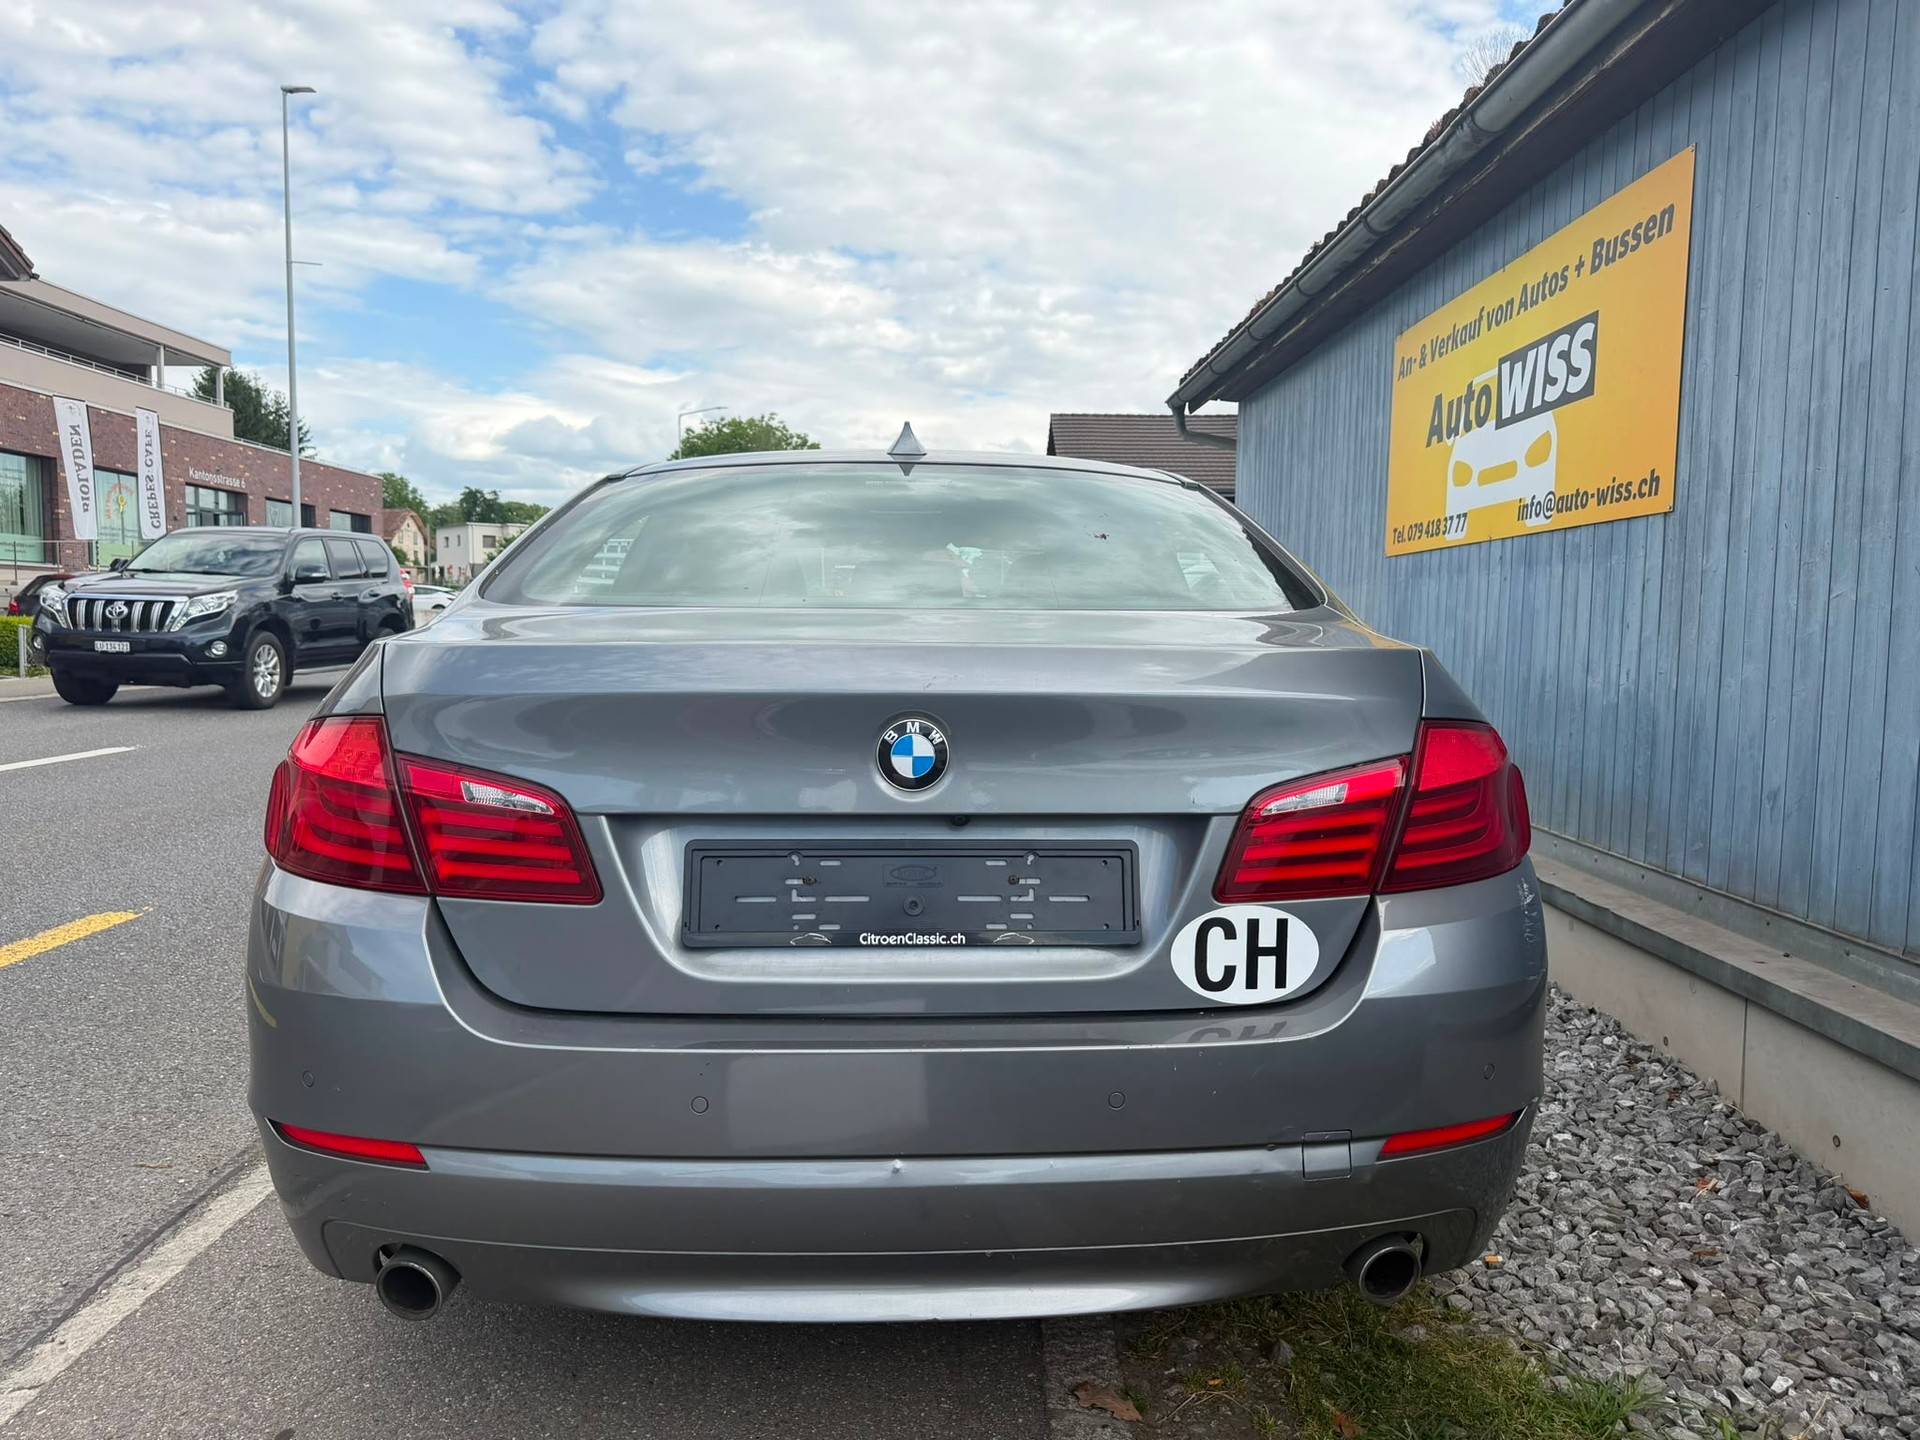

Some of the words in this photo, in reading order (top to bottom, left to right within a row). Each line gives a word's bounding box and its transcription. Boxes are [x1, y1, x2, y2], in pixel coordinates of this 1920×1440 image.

[1397, 352, 1417, 381] An-
[1418, 343, 1428, 369] &
[1430, 306, 1485, 363] Verkauf
[1486, 296, 1515, 332] von
[1516, 264, 1570, 317] Autos
[1574, 254, 1586, 278] +
[1590, 203, 1675, 275] Bussen
[1425, 380, 1492, 448] Auto
[1501, 322, 1596, 420] WISS
[189, 466, 240, 488] Kantonsstrasse
[241, 478, 246, 489] 6
[1517, 468, 1661, 521] info@auto-wiss.ch
[1392, 525, 1406, 545] Tel.
[1407, 522, 1424, 542] 079
[1425, 517, 1441, 538] 418
[1442, 514, 1454, 535] 37
[1455, 512, 1468, 533] 77
[883, 721, 943, 745] BMW
[859, 932, 966, 945] CitroenClassic.ch
[1194, 917, 1288, 992] CH
